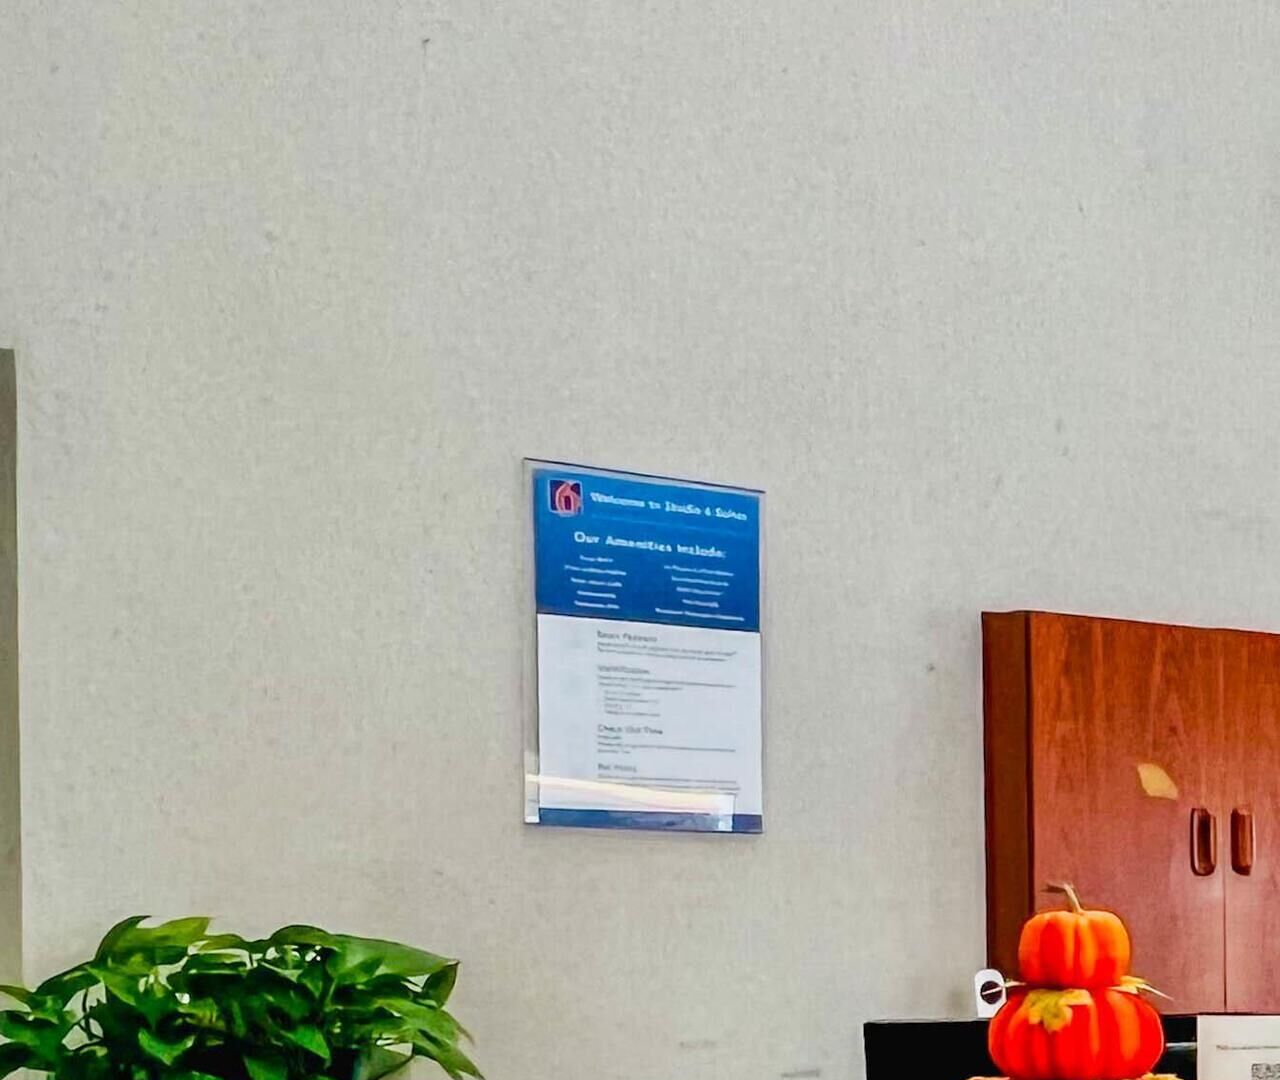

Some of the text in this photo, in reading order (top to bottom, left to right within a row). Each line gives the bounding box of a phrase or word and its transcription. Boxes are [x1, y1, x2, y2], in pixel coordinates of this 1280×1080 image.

[590, 491, 645, 509] Welcome
[649, 500, 662, 511] to
[573, 530, 600, 545] Our
[605, 534, 673, 553] Amenities
